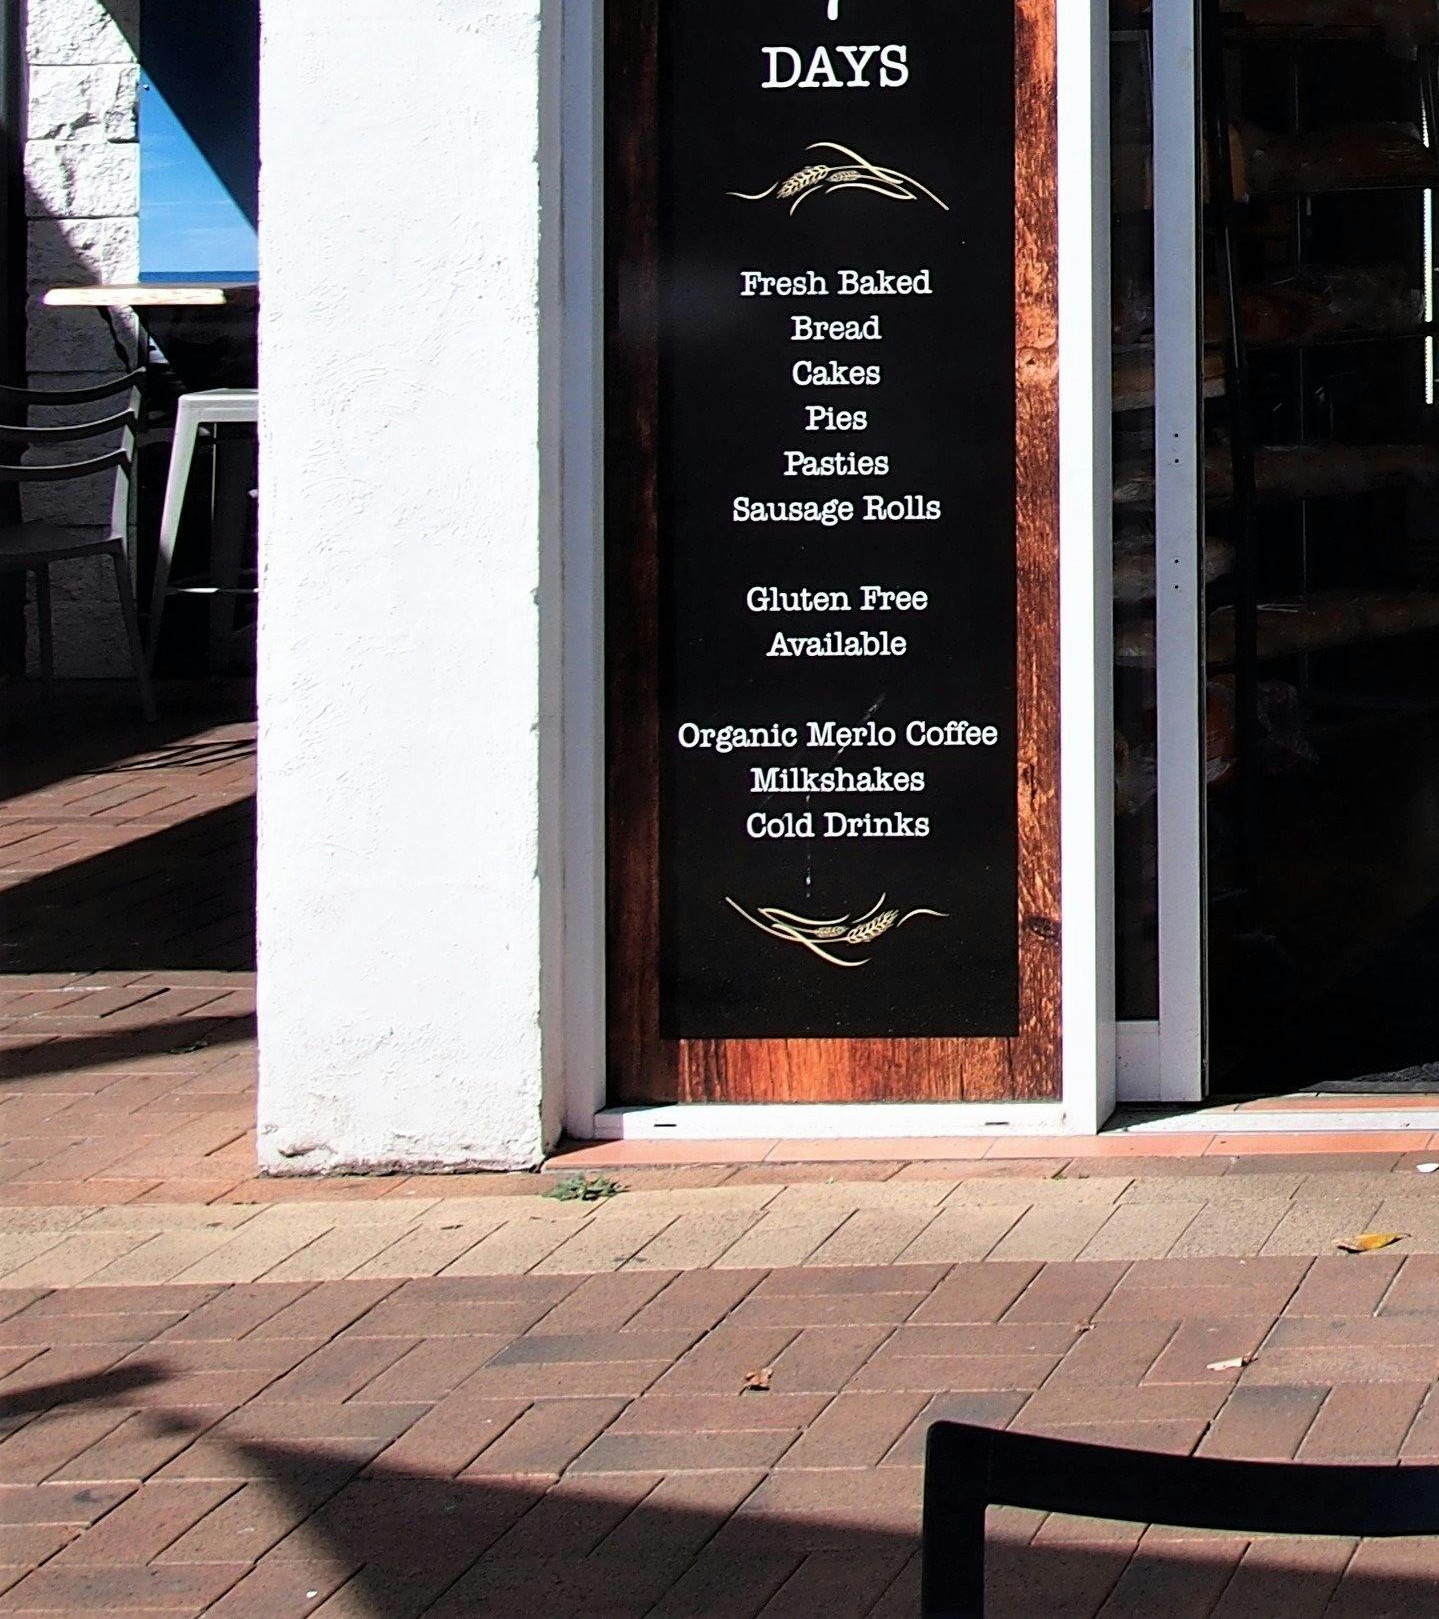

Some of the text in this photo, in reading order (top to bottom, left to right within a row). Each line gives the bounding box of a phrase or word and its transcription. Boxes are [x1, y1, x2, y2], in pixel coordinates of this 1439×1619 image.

[761, 44, 909, 89] DAYS
[740, 269, 933, 296] Fresh Baked
[790, 314, 883, 341] Bread
[792, 360, 881, 386] Cakes
[804, 405, 868, 431] Pies
[783, 450, 890, 476] Pasties
[732, 494, 942, 527] Sausage Rolls
[746, 585, 928, 612] Gluten Free
[765, 630, 907, 657] Available
[678, 720, 998, 754] Organic Merlo Coffee
[750, 766, 925, 793] Milkshakes
[746, 811, 930, 838] Cold Drinks
